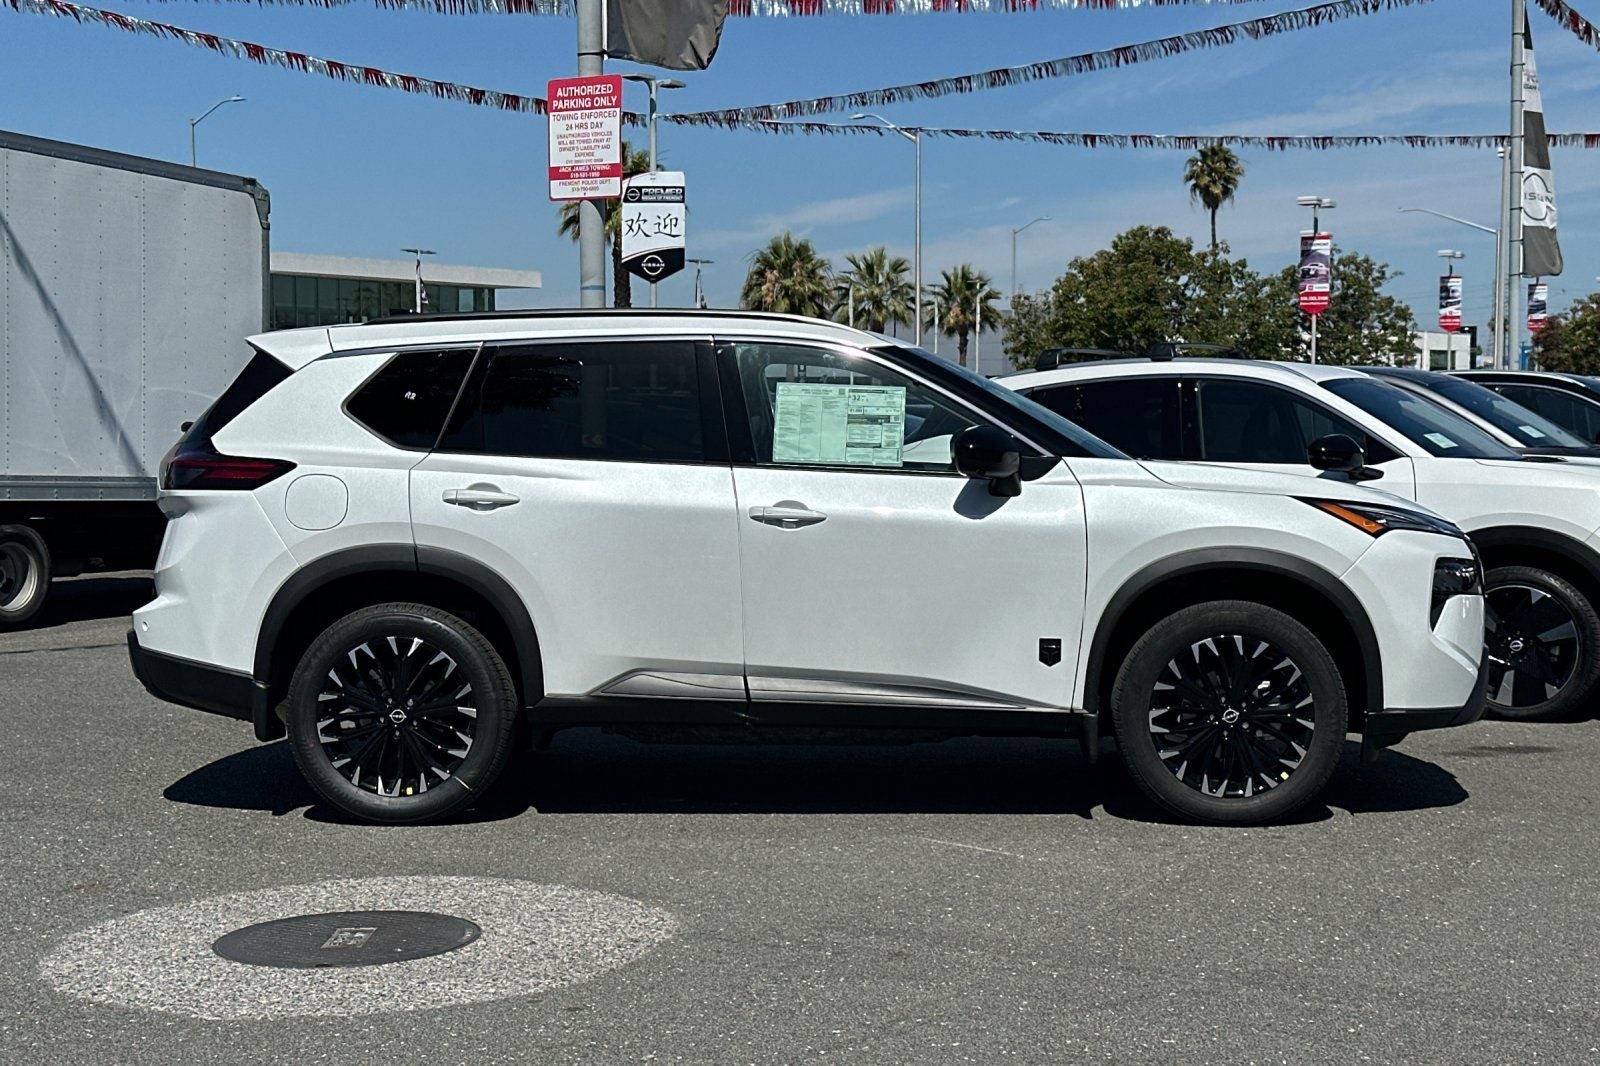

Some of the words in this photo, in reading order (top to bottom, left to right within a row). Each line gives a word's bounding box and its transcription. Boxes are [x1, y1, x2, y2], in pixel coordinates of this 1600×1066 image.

[556, 84, 613, 97] AUTHORIZED
[552, 98, 592, 110] PARKING
[593, 96, 617, 106] ONLY
[552, 112, 579, 123] TOWING
[580, 110, 618, 121] ENFORCED
[565, 123, 573, 131] 24
[574, 122, 589, 130] HRS
[590, 121, 604, 130] DAY
[624, 210, 683, 239] 欢迎
